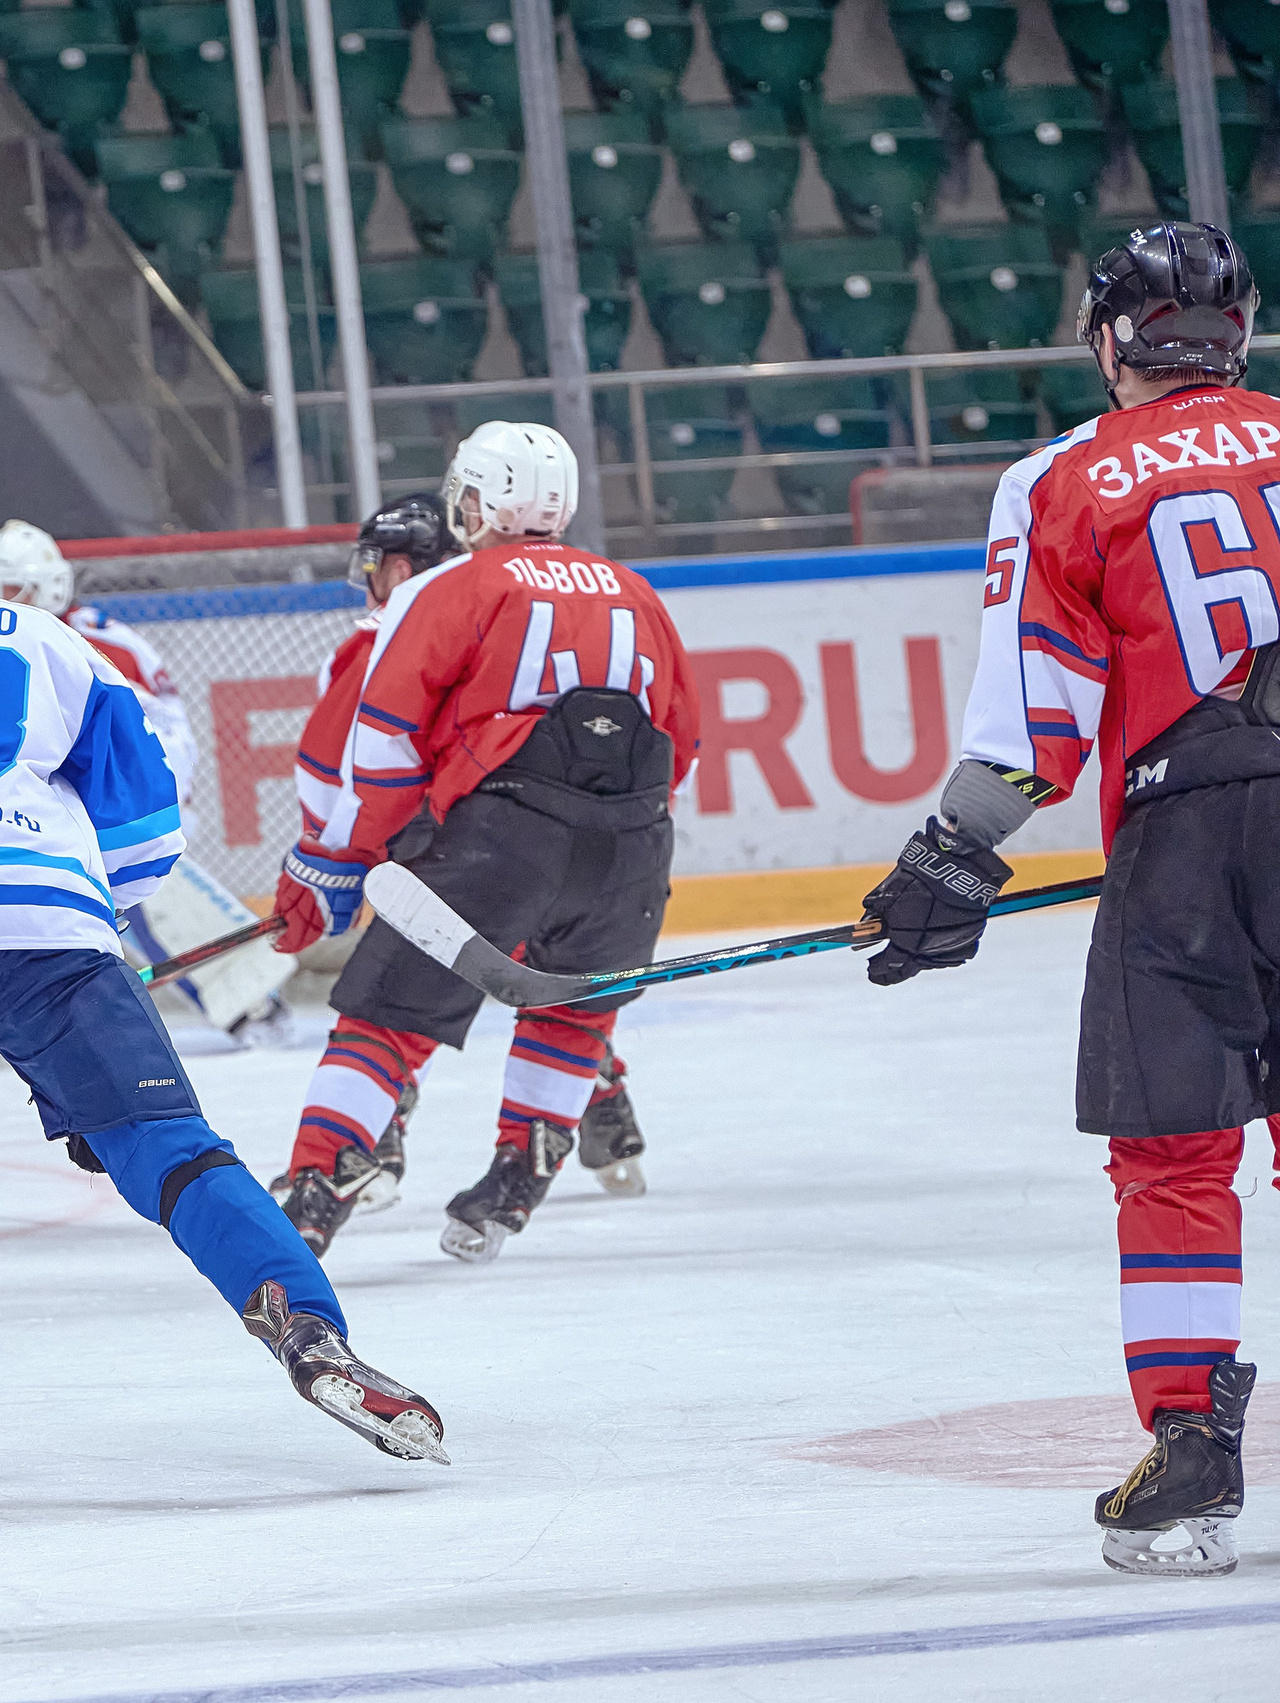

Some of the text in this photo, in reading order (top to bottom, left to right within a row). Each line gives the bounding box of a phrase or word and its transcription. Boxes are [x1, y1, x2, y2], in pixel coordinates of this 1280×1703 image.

[1172, 395, 1226, 410] LUTCH
[1087, 420, 1280, 499] ЗАХАР
[502, 556, 621, 595] ЛЬВОВ
[1146, 481, 1280, 698] 6
[285, 853, 360, 889] ARRIOR
[901, 838, 1000, 907] AUER
[138, 1078, 177, 1088] BAUER
